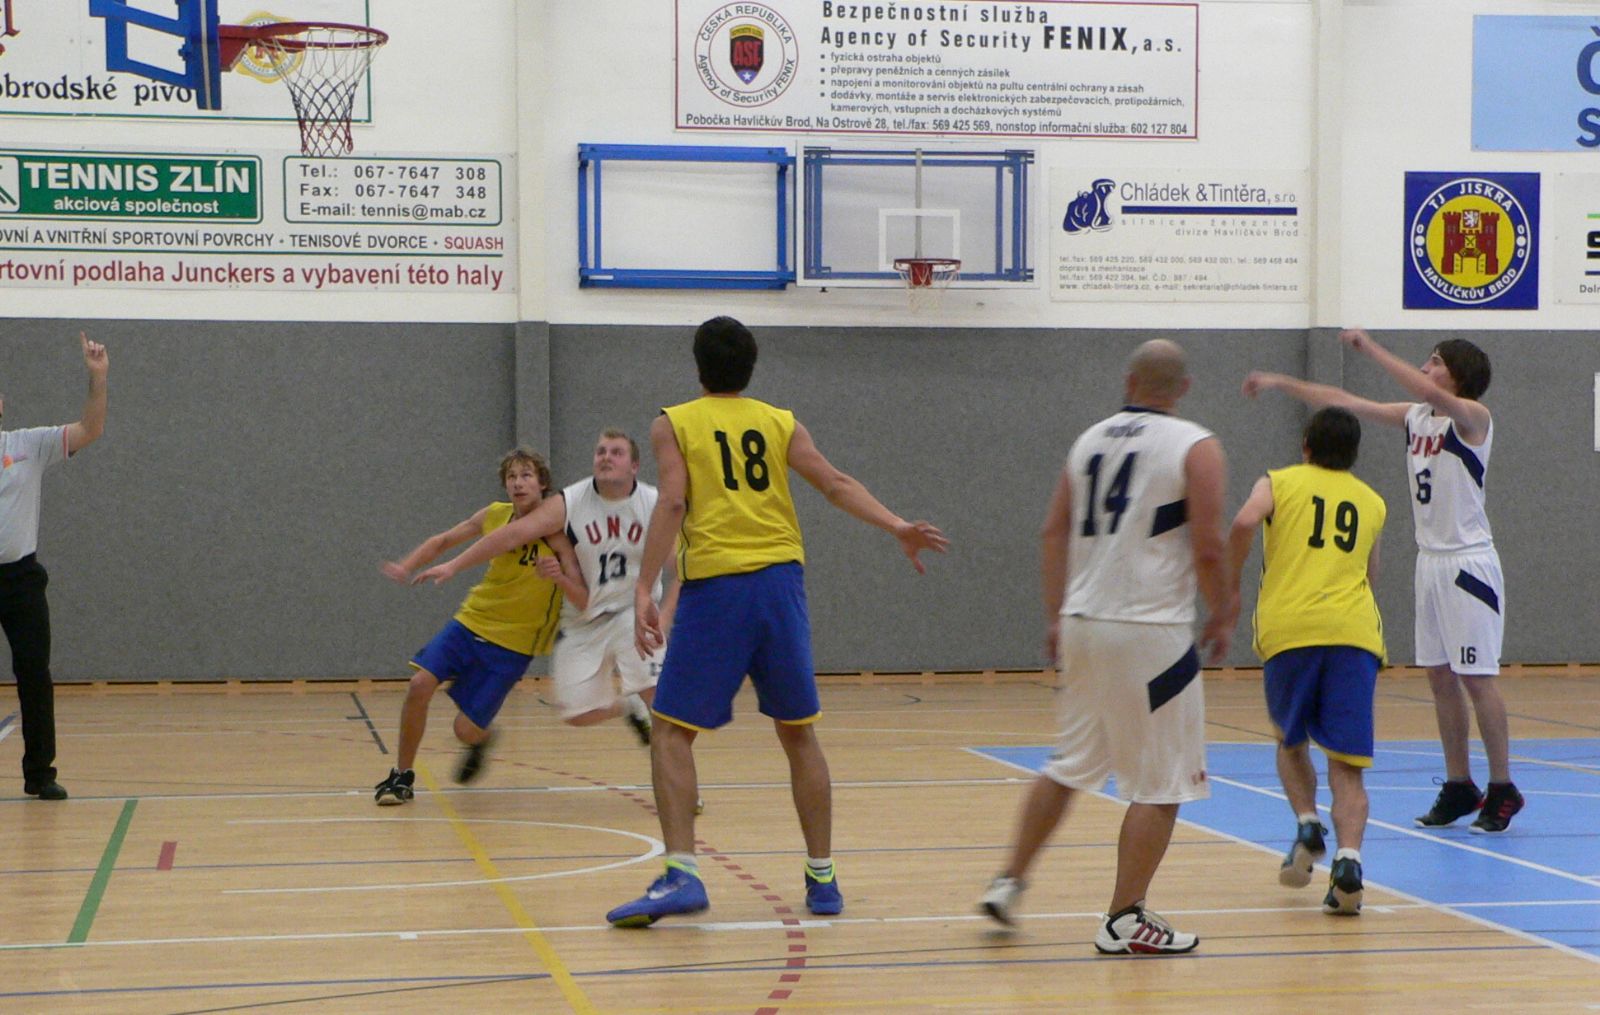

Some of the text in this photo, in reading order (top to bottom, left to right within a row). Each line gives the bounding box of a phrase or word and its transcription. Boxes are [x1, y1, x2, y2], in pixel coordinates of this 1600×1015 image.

[823, 1, 1048, 23] Bezpečnostní služba
[735, 5, 793, 44] REPUBLIKA
[821, 27, 896, 49] Agency
[907, 29, 927, 46] of
[940, 29, 1031, 53] Security
[830, 52, 941, 64] fyzická ostraha objektů
[697, 54, 796, 103] Agency of Security FENIX
[830, 66, 873, 75] přepravy
[935, 68, 975, 78] cenných
[977, 69, 1010, 78] zásilek
[876, 91, 916, 101] montáže
[926, 93, 955, 101] servis
[957, 92, 1027, 103] elektronických
[948, 81, 984, 91] objektů
[1000, 81, 1024, 92] pultu
[1070, 84, 1108, 94] ochrany
[1116, 85, 1144, 93] zásah
[951, 105, 1020, 117] docházkových
[1022, 106, 1062, 117] systémů
[686, 113, 730, 126] Pobočka
[786, 115, 813, 129] Brod,
[816, 117, 830, 128] Na
[832, 118, 872, 129] Ostrově
[932, 119, 950, 131] 569
[952, 120, 970, 131] 425
[996, 122, 1036, 133] nonstop
[1130, 123, 1148, 133] 602
[1150, 123, 1168, 134] 127
[1170, 123, 1187, 134] 804
[23, 160, 250, 193] TENNIS ZLÍN
[300, 164, 487, 180] Tel.: 067-7647 308
[300, 183, 487, 199] Fax: 067-7647 348
[1120, 182, 1190, 202] Chládek
[1428, 182, 1514, 212] TJ JISKRA
[54, 196, 219, 214] akciová společnost
[300, 203, 486, 220] E-mail: tennis@mab.cz
[0, 226, 504, 250] VNÍ A VNITŘNÍ SPORTOVNÍ POVRCHY TENISOVÉ DVORCE SQUASH
[1175, 228, 1208, 236] divize
[1273, 229, 1299, 237] Brod
[73, 261, 165, 286] podlaha
[171, 261, 275, 283] Junckers
[283, 266, 295, 283] a
[301, 263, 400, 289] vybavení
[408, 263, 449, 285] této
[457, 265, 504, 291] haly
[1423, 267, 1517, 299] HAVLÍČKŮV BROD
[714, 429, 770, 492] 18
[1081, 451, 1139, 536] 14
[1415, 468, 1432, 505] 6
[585, 514, 644, 545] UNO
[1308, 495, 1359, 553] 19
[599, 552, 627, 585] 13
[1460, 647, 1476, 665] 16
